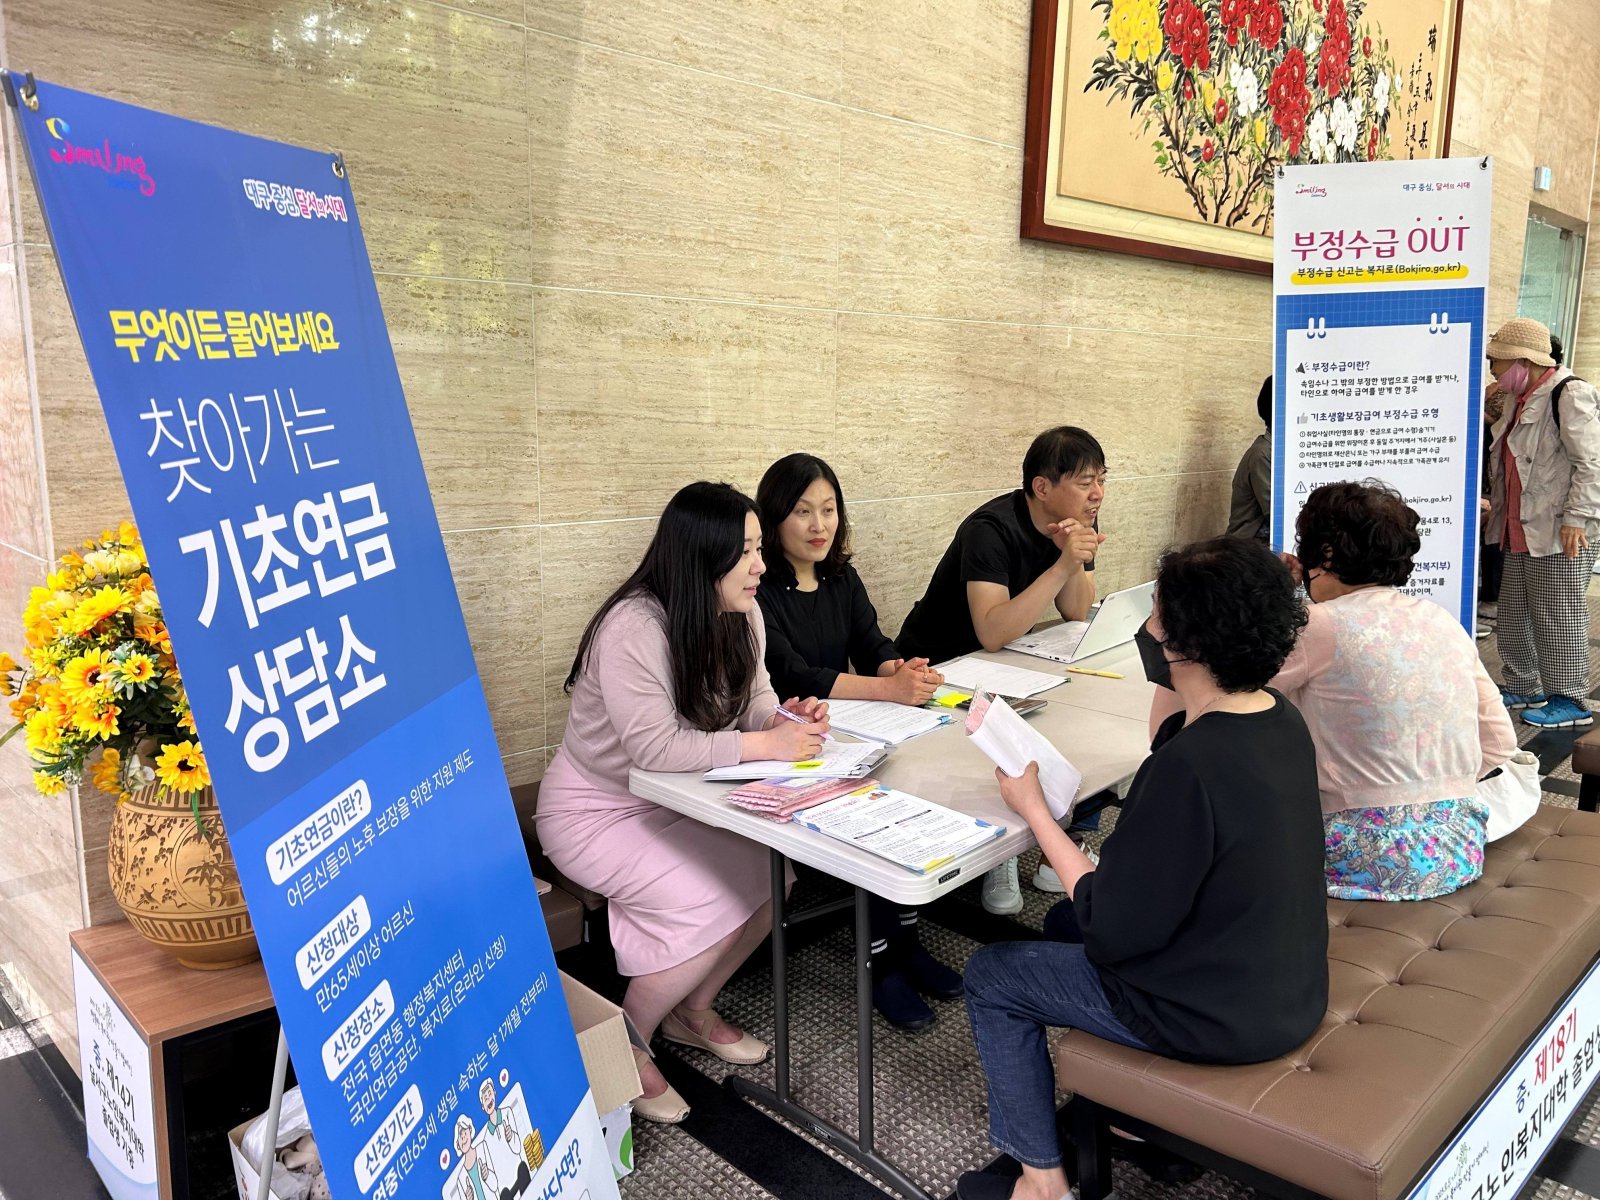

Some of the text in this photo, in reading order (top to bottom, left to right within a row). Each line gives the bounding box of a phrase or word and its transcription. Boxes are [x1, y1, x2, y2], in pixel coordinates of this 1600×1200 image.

[243, 179, 271, 210] 대구
[294, 188, 328, 219] 달서의
[324, 195, 347, 222] 시대
[1402, 181, 1471, 192] 대구 중심, 달서의 시대
[1290, 216, 1471, 262] 부정수급 OUT
[1297, 262, 1461, 279] 부정수급 신고는 복지로(Bokjiro.go.kr)
[1300, 374, 1459, 389] 속임수나 그 밖의 부정한 방법으로 급여를 받거나,
[1300, 389, 1328, 398] 타인으로
[1331, 387, 1352, 397] 하여금
[1354, 386, 1376, 396] 급여를
[1377, 386, 1392, 396] 받게
[1404, 385, 1418, 395] 경우
[1311, 360, 1370, 372] 부정수급이란?
[140, 387, 340, 503] 찾아가는
[1310, 407, 1439, 423] 기초생활보장급여 부정수급 유형
[1428, 446, 1440, 454] 수급
[1438, 456, 1450, 464] 유지
[1404, 494, 1452, 504] bokjiro.go.kr)
[1415, 527, 1432, 537] 당관
[1420, 516, 1453, 526] 움4로 13,
[178, 482, 396, 629] 기초연금
[1409, 577, 1446, 587] 증거자료를
[1414, 561, 1451, 572] 건복지부)
[224, 614, 387, 773] 상담소
[275, 789, 363, 871] 기초연금이란?
[287, 748, 474, 907] 어르신들의 노후 보장을 위한 지원 제도
[305, 909, 360, 976] 신청대상
[315, 899, 415, 1013] 만65세이상 어르신
[333, 997, 387, 1066] 신청장소
[340, 948, 466, 1103] 전국 읍면동 행정복지센터
[350, 934, 508, 1127] 국민연금공단, 복지로(온라인 신청)
[437, 1083, 459, 1124] 생일
[457, 1051, 489, 1092] 속하는
[486, 1031, 500, 1058] 달
[498, 1005, 522, 1042] 1개월
[519, 971, 549, 1015] 전부터)
[1534, 1007, 1577, 1086] 제18기
[89, 1063, 144, 1163] 달서구노인복지대학
[105, 1057, 136, 1123] 제14기
[101, 1104, 135, 1170] 졸업생 기증
[366, 1098, 415, 1177] 신청기간
